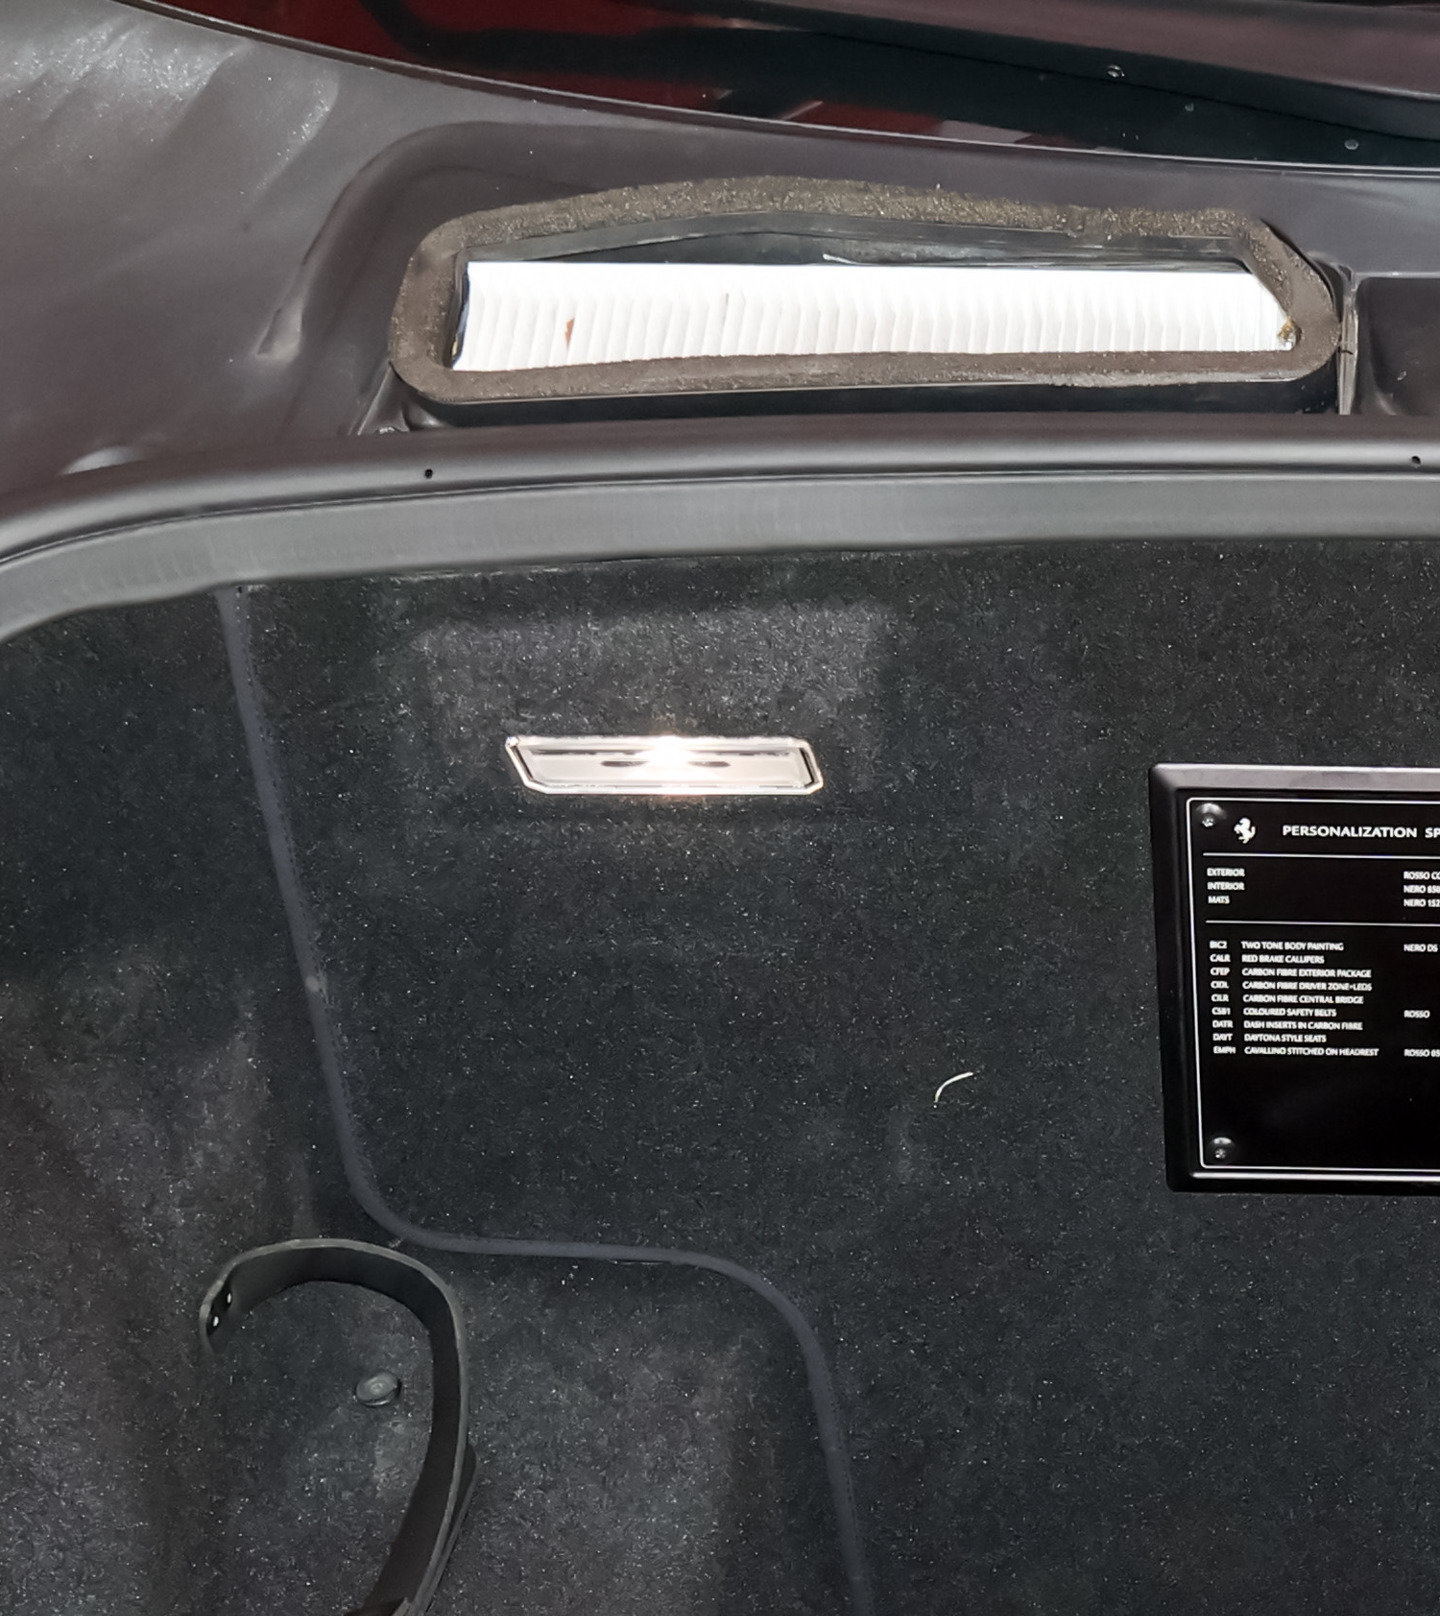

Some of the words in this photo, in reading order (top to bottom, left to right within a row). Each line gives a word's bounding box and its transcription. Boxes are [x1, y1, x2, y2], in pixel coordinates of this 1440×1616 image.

[1283, 825, 1417, 837] PERSONALIZATION
[1207, 868, 1245, 876] EXTERIOR
[1404, 871, 1430, 880] ROSSO
[1208, 882, 1244, 890] INTERIOR
[1404, 885, 1426, 893] NERO
[1208, 896, 1229, 904] MATS
[1404, 899, 1426, 907] NERO
[1428, 899, 1440, 907] 152
[1241, 941, 1261, 949] TWO
[1285, 942, 1306, 950] BODY
[1307, 942, 1344, 950] PAINTING
[1404, 944, 1426, 952] NERO
[1427, 944, 1438, 952] DS
[1210, 954, 1230, 962] CALR
[1259, 955, 1284, 963] BRAKE
[1210, 967, 1230, 975] CFEP
[1242, 968, 1275, 976] CARBON
[1277, 968, 1297, 976] FIBRE
[1299, 969, 1335, 977] EXTERIOR
[1337, 969, 1371, 977] PACKAGE
[1242, 981, 1275, 989] CARBON
[1299, 982, 1326, 990] DRIVER
[1243, 994, 1276, 1002] CARBON
[1277, 995, 1298, 1003] FIBRE
[1299, 995, 1334, 1003] CENTRAL
[1335, 996, 1363, 1004] BRIDGE
[1287, 1008, 1313, 1016] SAFETY
[1314, 1009, 1336, 1017] BELTS
[1404, 1010, 1430, 1018] ROSSO
[1213, 1020, 1233, 1028] DATR
[1244, 1020, 1265, 1028] DASH
[1266, 1021, 1297, 1029] INSERTS
[1308, 1022, 1340, 1030] CARBON
[1342, 1022, 1362, 1030] FIBRE
[1213, 1033, 1233, 1041] DAYT
[1281, 1034, 1303, 1042] STYLE
[1287, 1047, 1324, 1055] STITCHED
[1339, 1048, 1379, 1056] HEADREST
[1404, 1049, 1430, 1057] ROSSO
